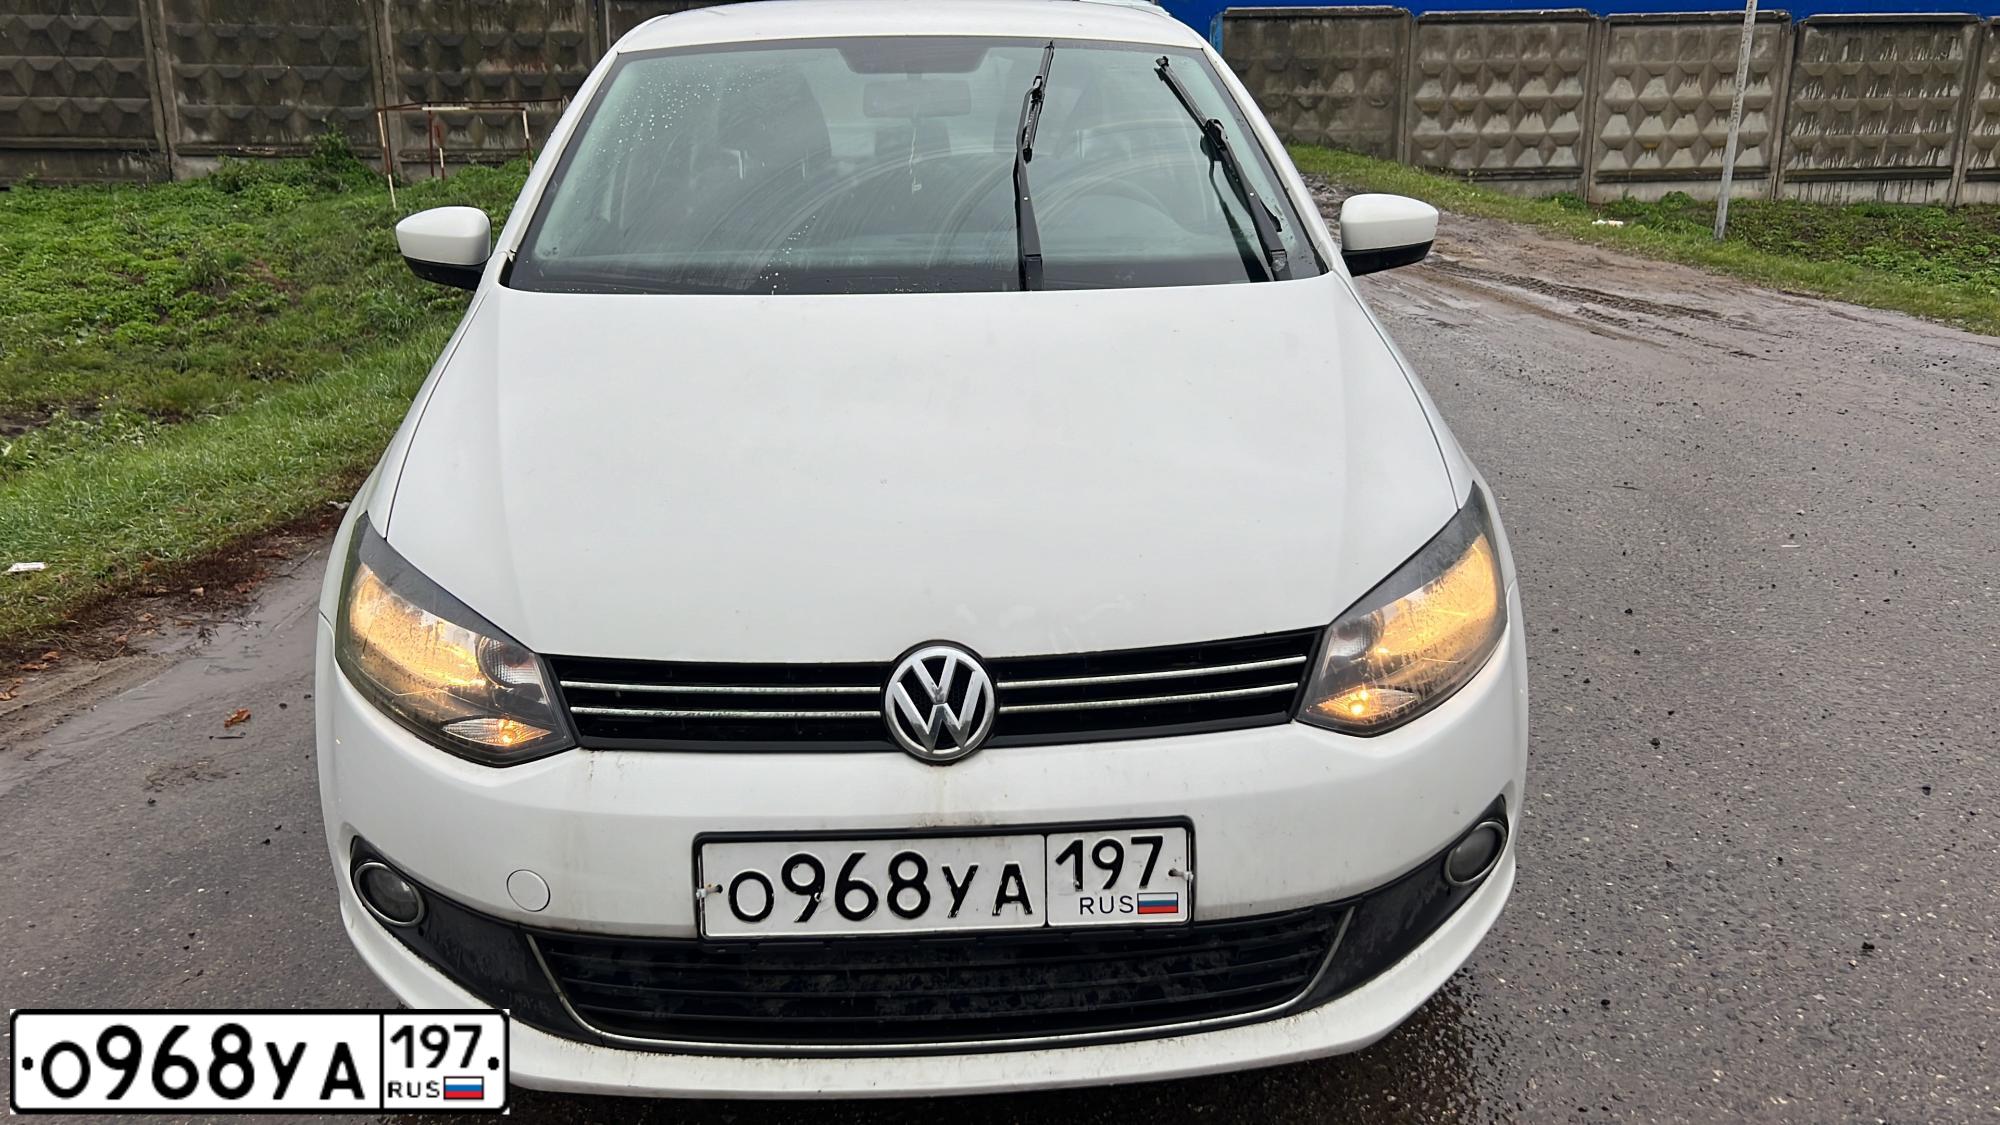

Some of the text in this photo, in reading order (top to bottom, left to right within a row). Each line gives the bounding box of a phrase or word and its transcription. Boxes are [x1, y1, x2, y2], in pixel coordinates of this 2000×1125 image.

[889, 648, 990, 756] VW
[1055, 835, 1165, 892] 197
[1079, 894, 1134, 915] RUS
